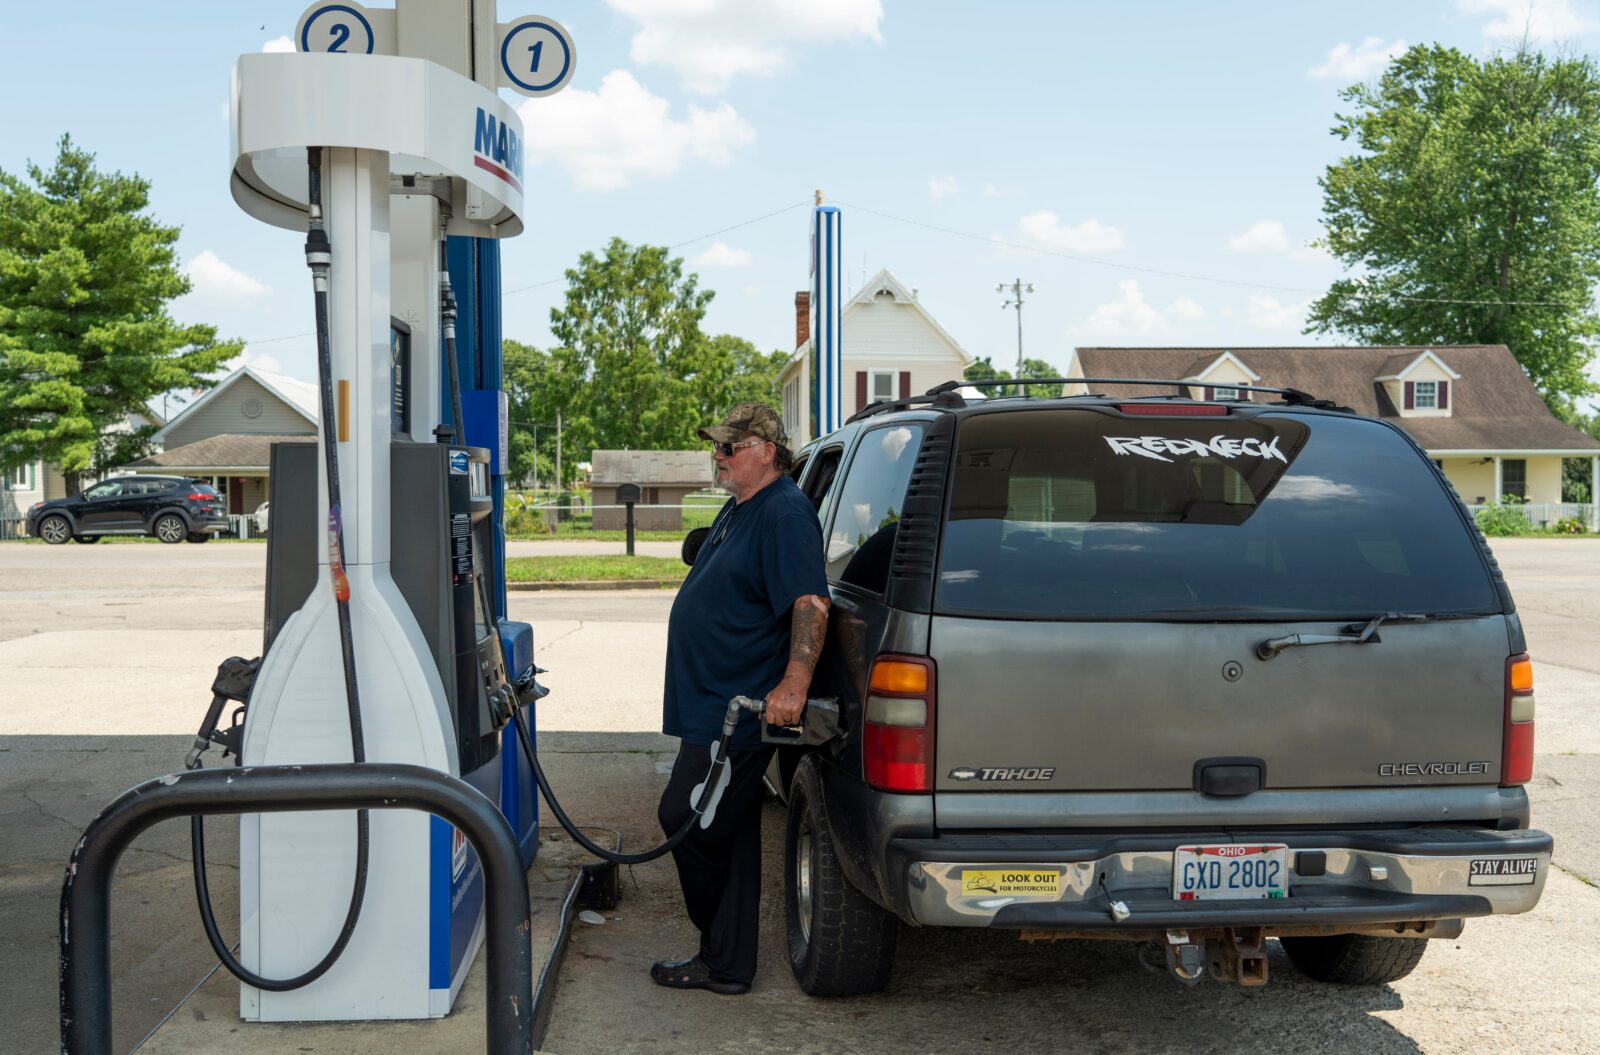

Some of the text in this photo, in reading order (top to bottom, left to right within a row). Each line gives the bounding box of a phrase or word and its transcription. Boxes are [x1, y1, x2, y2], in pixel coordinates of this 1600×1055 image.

[327, 24, 351, 53] 2
[527, 41, 544, 73] 1
[474, 107, 524, 183] MAR
[1102, 434, 1288, 464] REDNECK
[981, 768, 1055, 780] TAHOE
[1379, 761, 1494, 777] CHEVROLET
[1218, 847, 1246, 856] OHIO
[1183, 859, 1280, 890] GXD 2802
[1470, 859, 1538, 874] STAY ALIVE!
[1001, 874, 1057, 883] LOOK OUT
